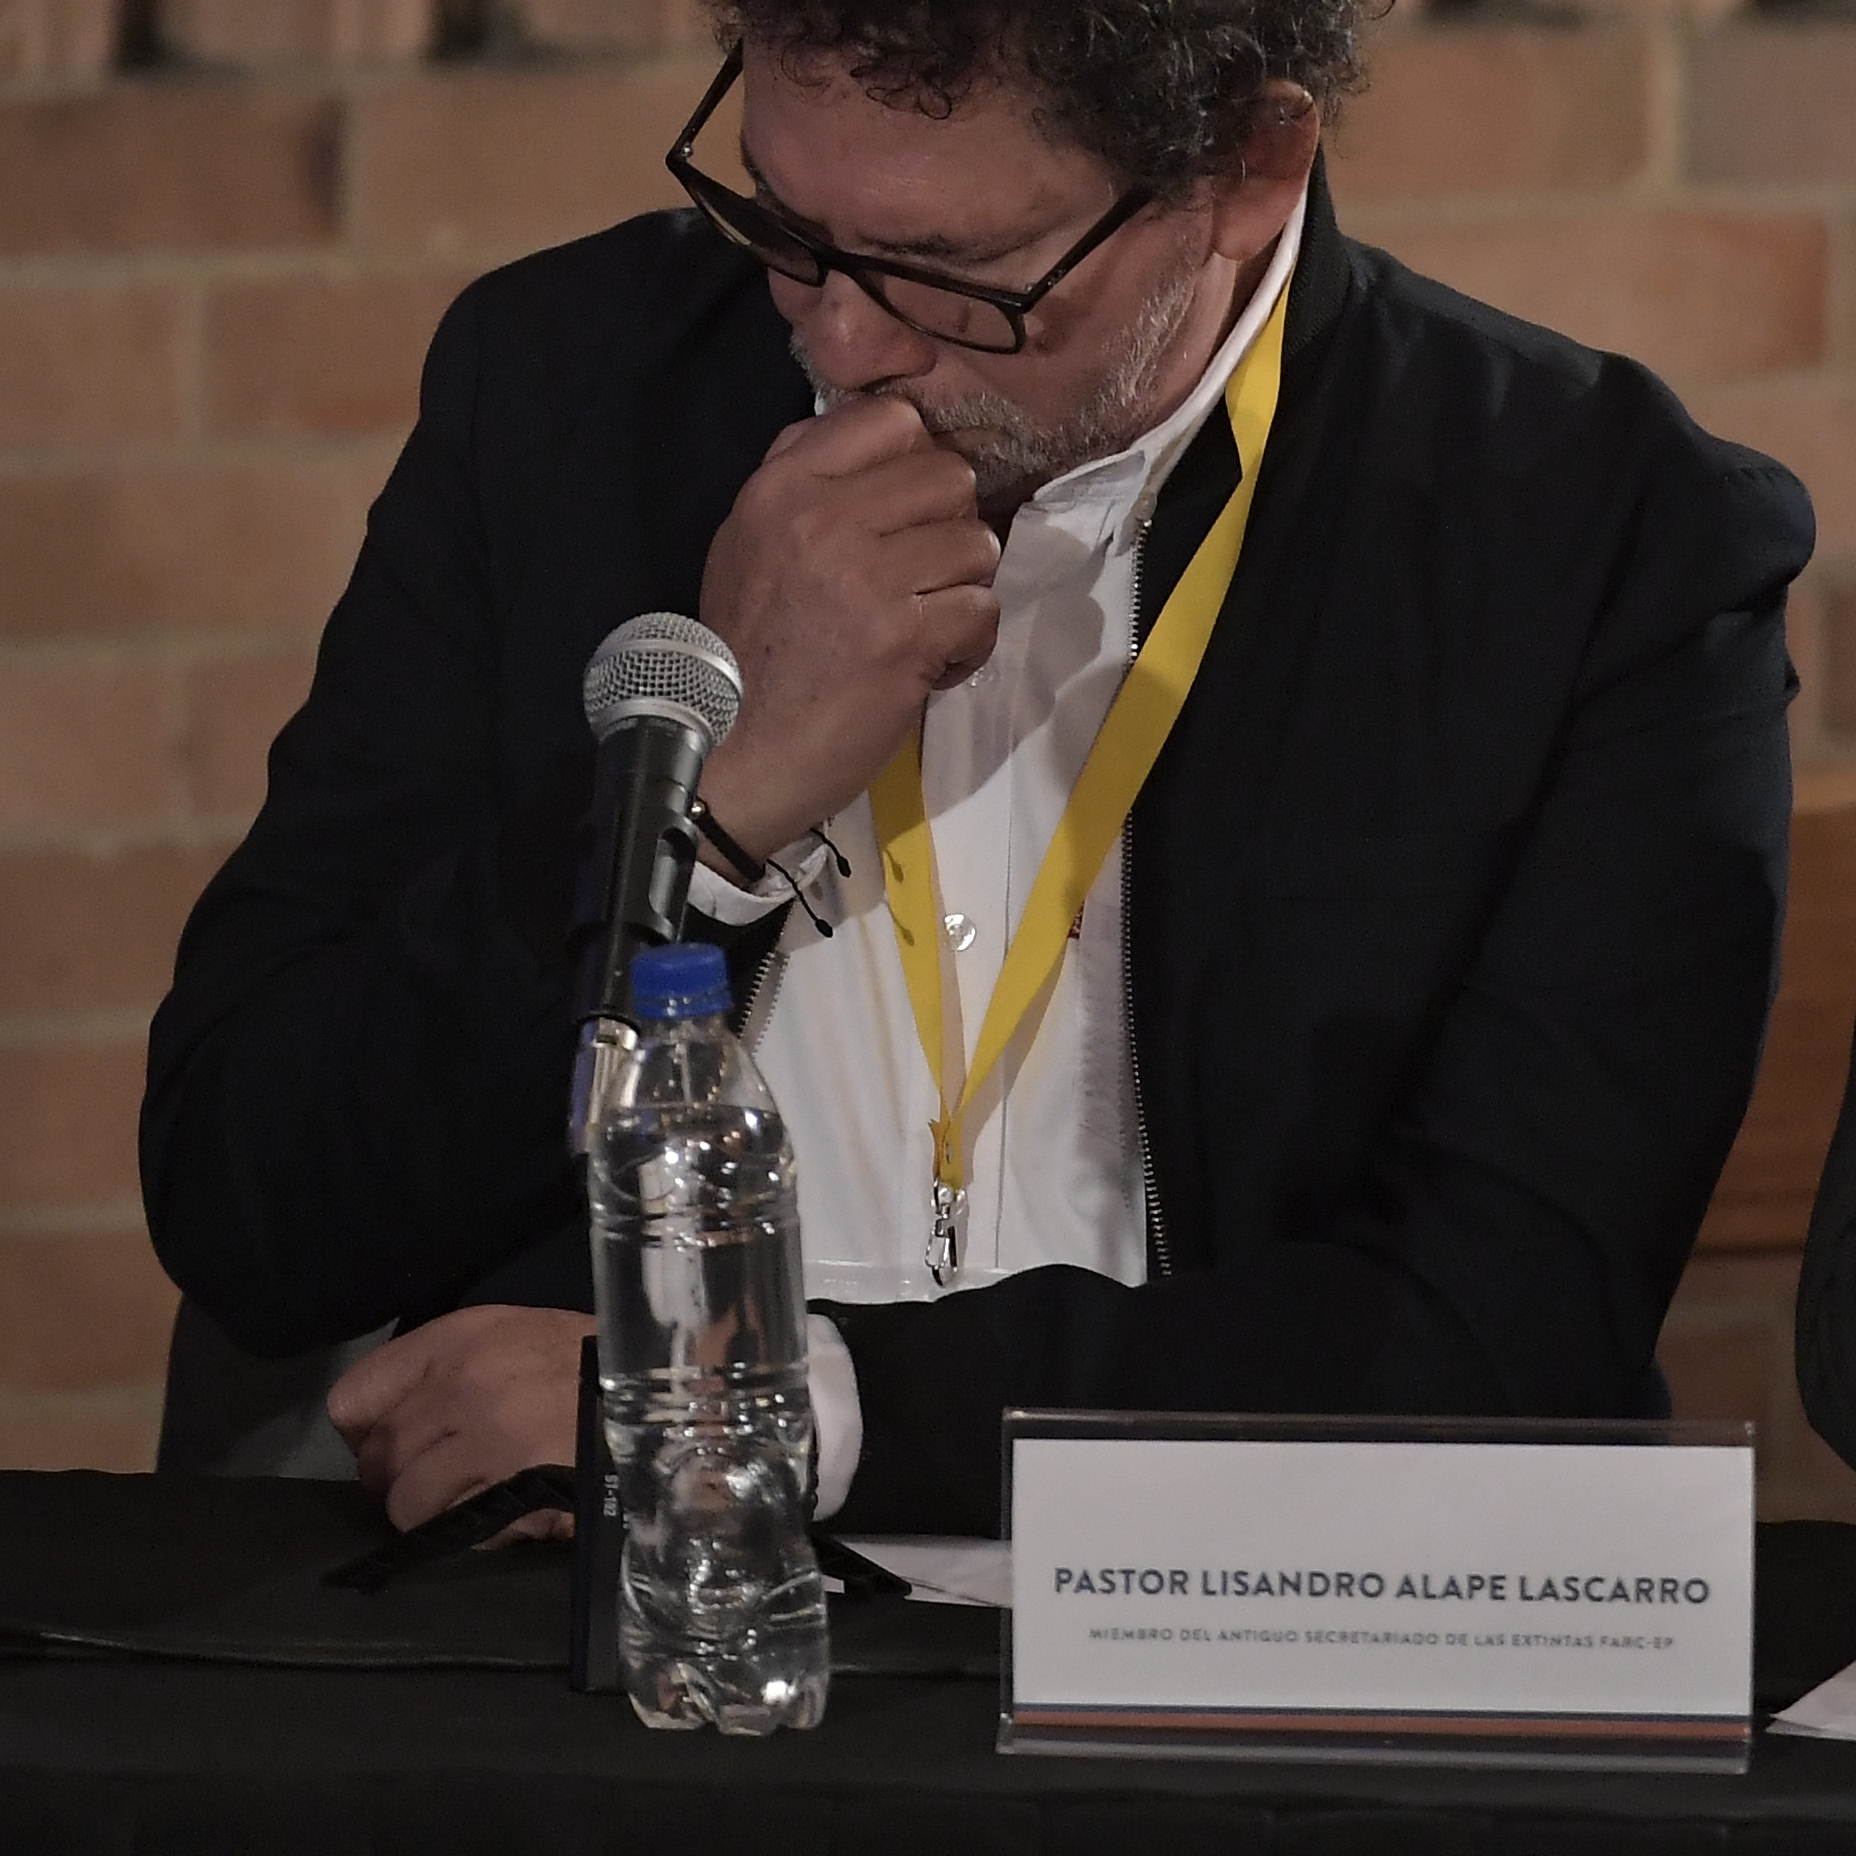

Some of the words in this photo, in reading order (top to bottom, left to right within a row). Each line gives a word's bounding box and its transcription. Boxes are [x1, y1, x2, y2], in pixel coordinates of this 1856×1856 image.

[1054, 1567, 1190, 1596] PASTOR
[1201, 1569, 1386, 1599] LISANDRO
[1394, 1573, 1507, 1602] ALAPE
[1518, 1575, 1711, 1605] LASCARRO
[1088, 1627, 1174, 1642] MIEMBRO
[1179, 1628, 1211, 1643] DEL
[1216, 1628, 1300, 1644] ANTIGUO
[1304, 1629, 1441, 1646] SECRETARIADO
[1444, 1632, 1469, 1647] DE
[1473, 1633, 1506, 1648] LAS
[1511, 1633, 1595, 1649] EXTINTAS
